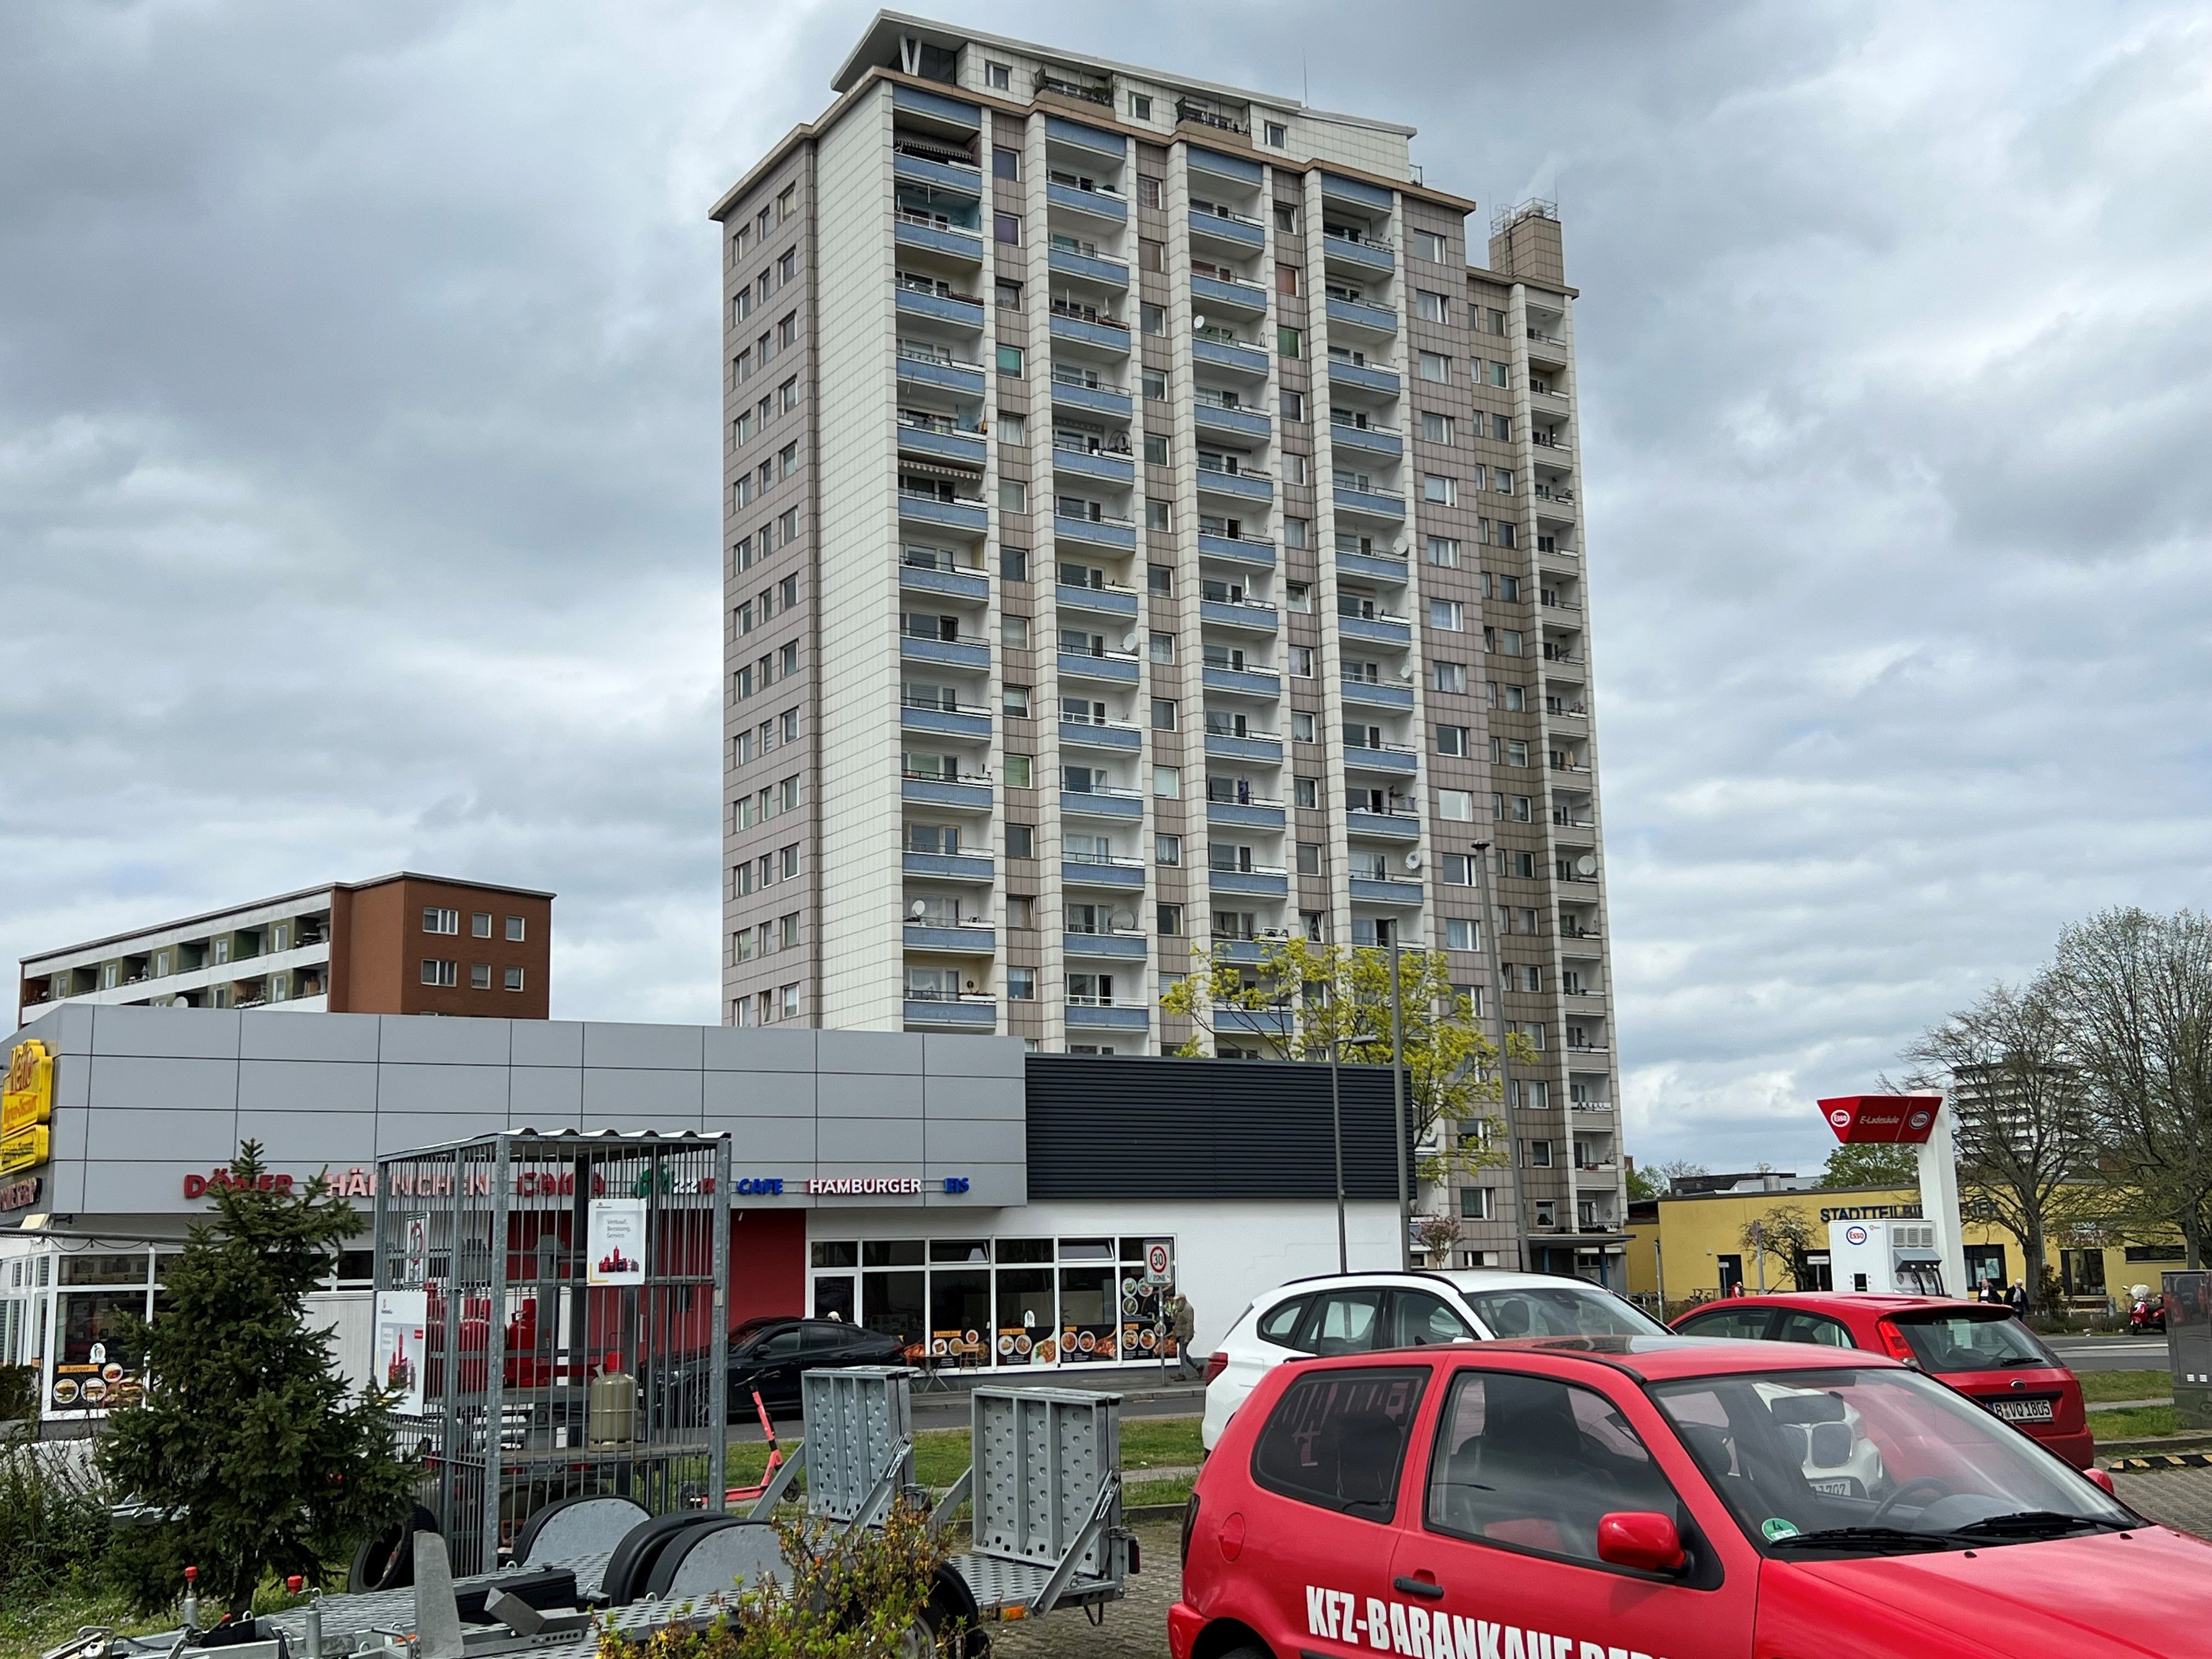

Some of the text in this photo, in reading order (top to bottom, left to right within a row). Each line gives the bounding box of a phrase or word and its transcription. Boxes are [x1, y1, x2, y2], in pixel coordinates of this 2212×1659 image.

[1833, 1114, 1847, 1122] Esso
[1860, 1115, 1900, 1124] E-Ladesäule
[1912, 1114, 1926, 1123] Esso
[325, 1167, 491, 1197] HÄNCHN
[808, 1178, 922, 1194] HAMBURGER
[944, 1177, 969, 1193] EIS
[1849, 1230, 1864, 1240] Esso
[1153, 1253, 1163, 1266] 30
[2009, 1402, 2024, 1417] VQ
[2024, 1402, 2051, 1417] 1805
[1772, 1520, 1784, 1531] 4
